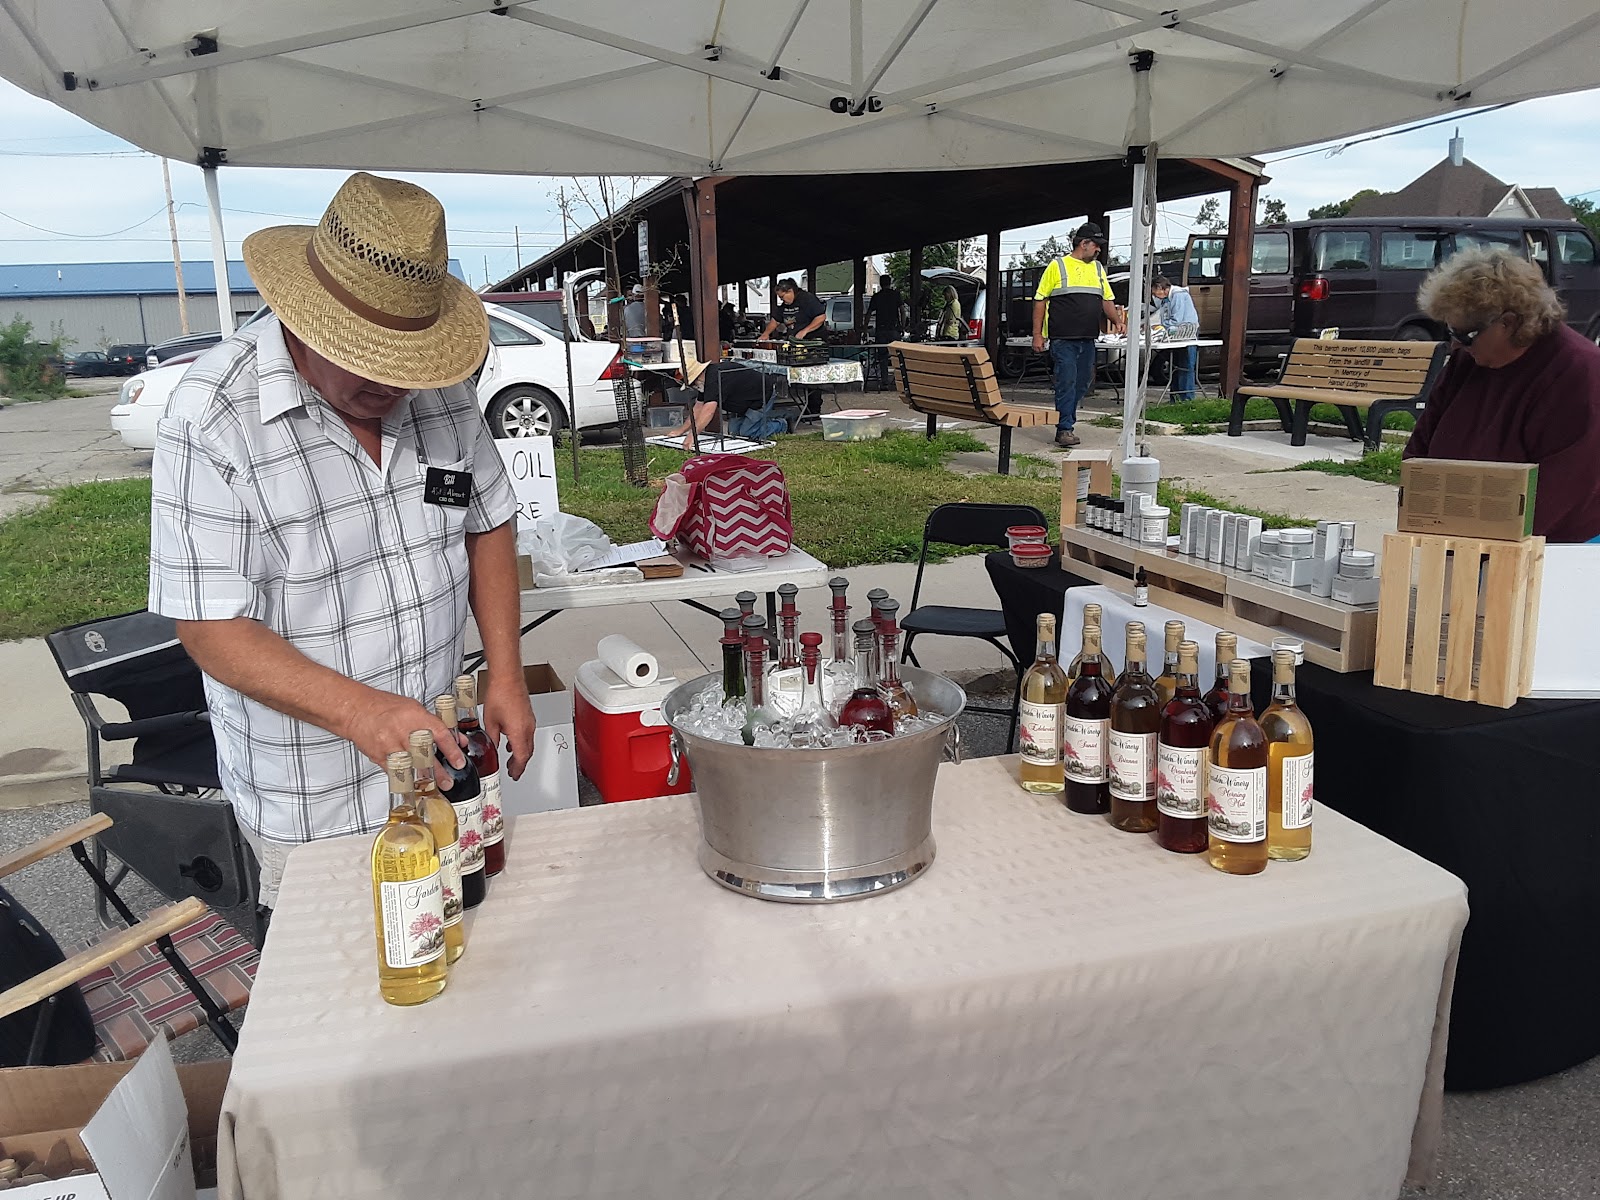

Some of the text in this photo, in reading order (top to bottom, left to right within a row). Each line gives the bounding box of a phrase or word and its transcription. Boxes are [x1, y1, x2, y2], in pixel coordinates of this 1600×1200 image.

[1341, 345, 1358, 353] saved
[1378, 346, 1396, 354] plastic
[1397, 347, 1411, 355] bags
[1328, 357, 1342, 365] From
[1342, 369, 1362, 378] Memory
[512, 450, 552, 480] OIL
[1031, 708, 1055, 721] Winery
[1075, 724, 1100, 737] Winery
[1114, 737, 1139, 753] Winery
[1170, 752, 1199, 768] Winery
[1168, 763, 1198, 778] Cranberry
[1220, 774, 1249, 791] Winery
[1217, 787, 1247, 801] Morning
[405, 882, 440, 910] Garden
